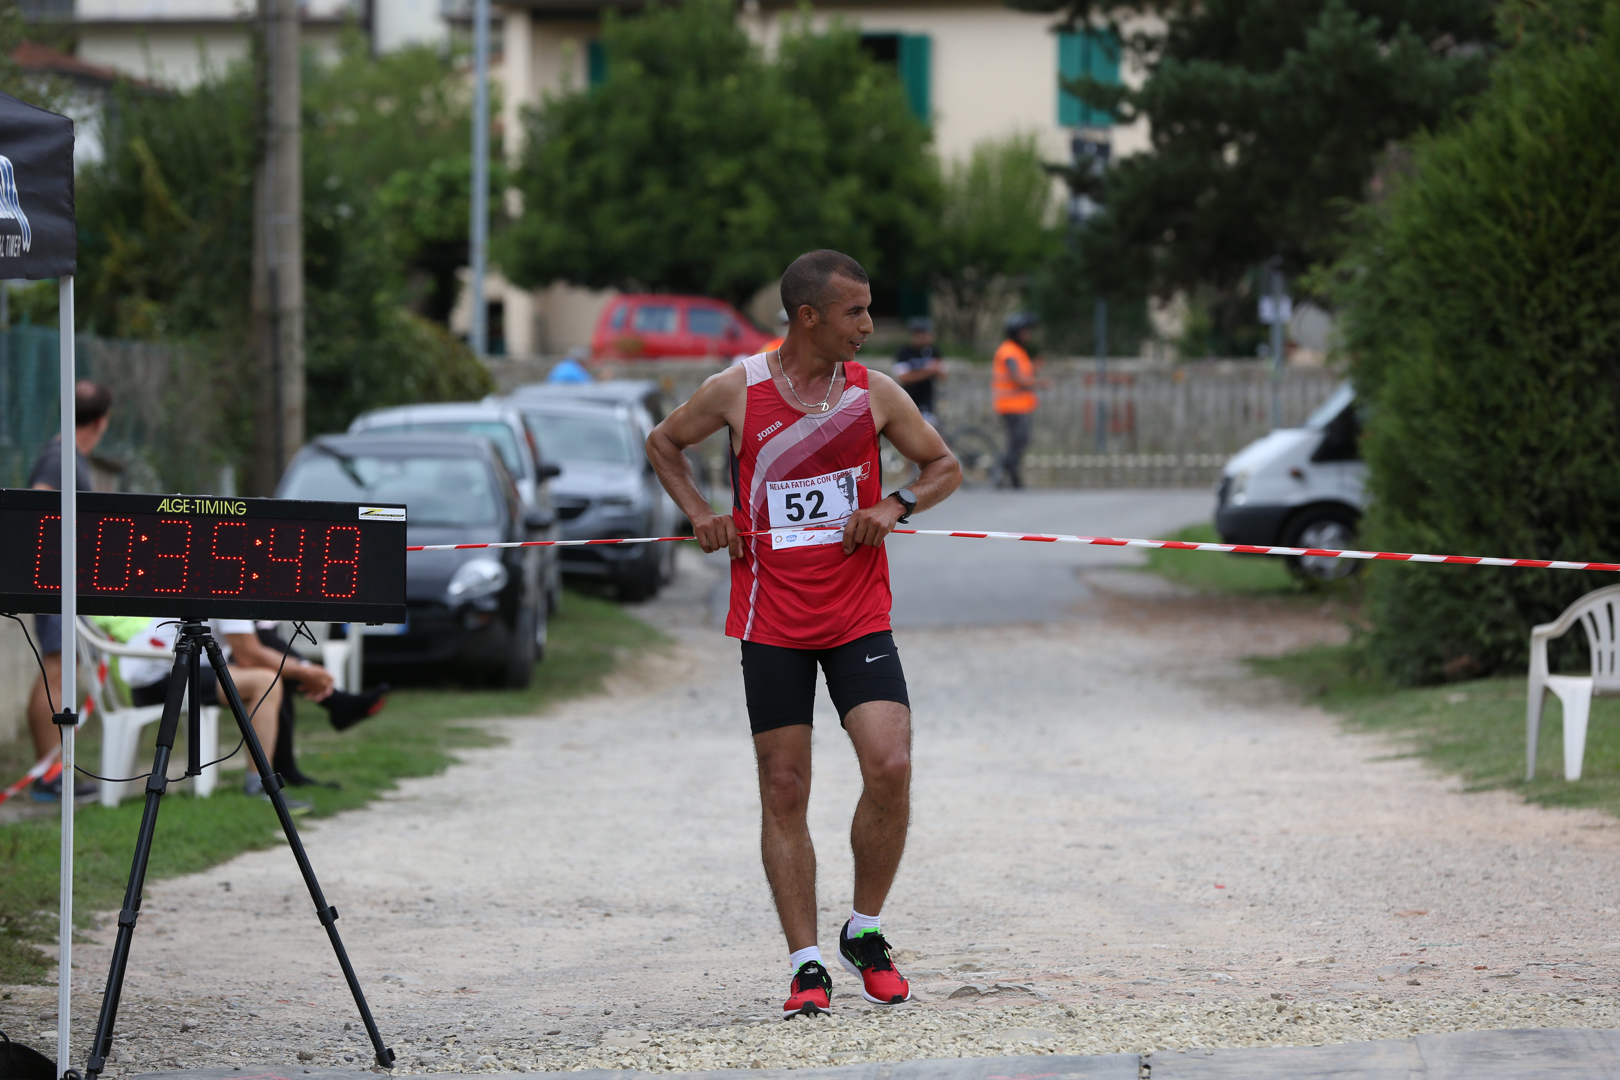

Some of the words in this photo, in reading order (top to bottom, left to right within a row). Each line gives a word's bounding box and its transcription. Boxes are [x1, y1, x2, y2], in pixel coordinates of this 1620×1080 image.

[791, 480, 816, 489] FATICA
[816, 476, 831, 484] CON
[156, 498, 247, 515] ALGE-TIMING
[785, 490, 828, 522] 52
[34, 515, 361, 598] 00:35:48
